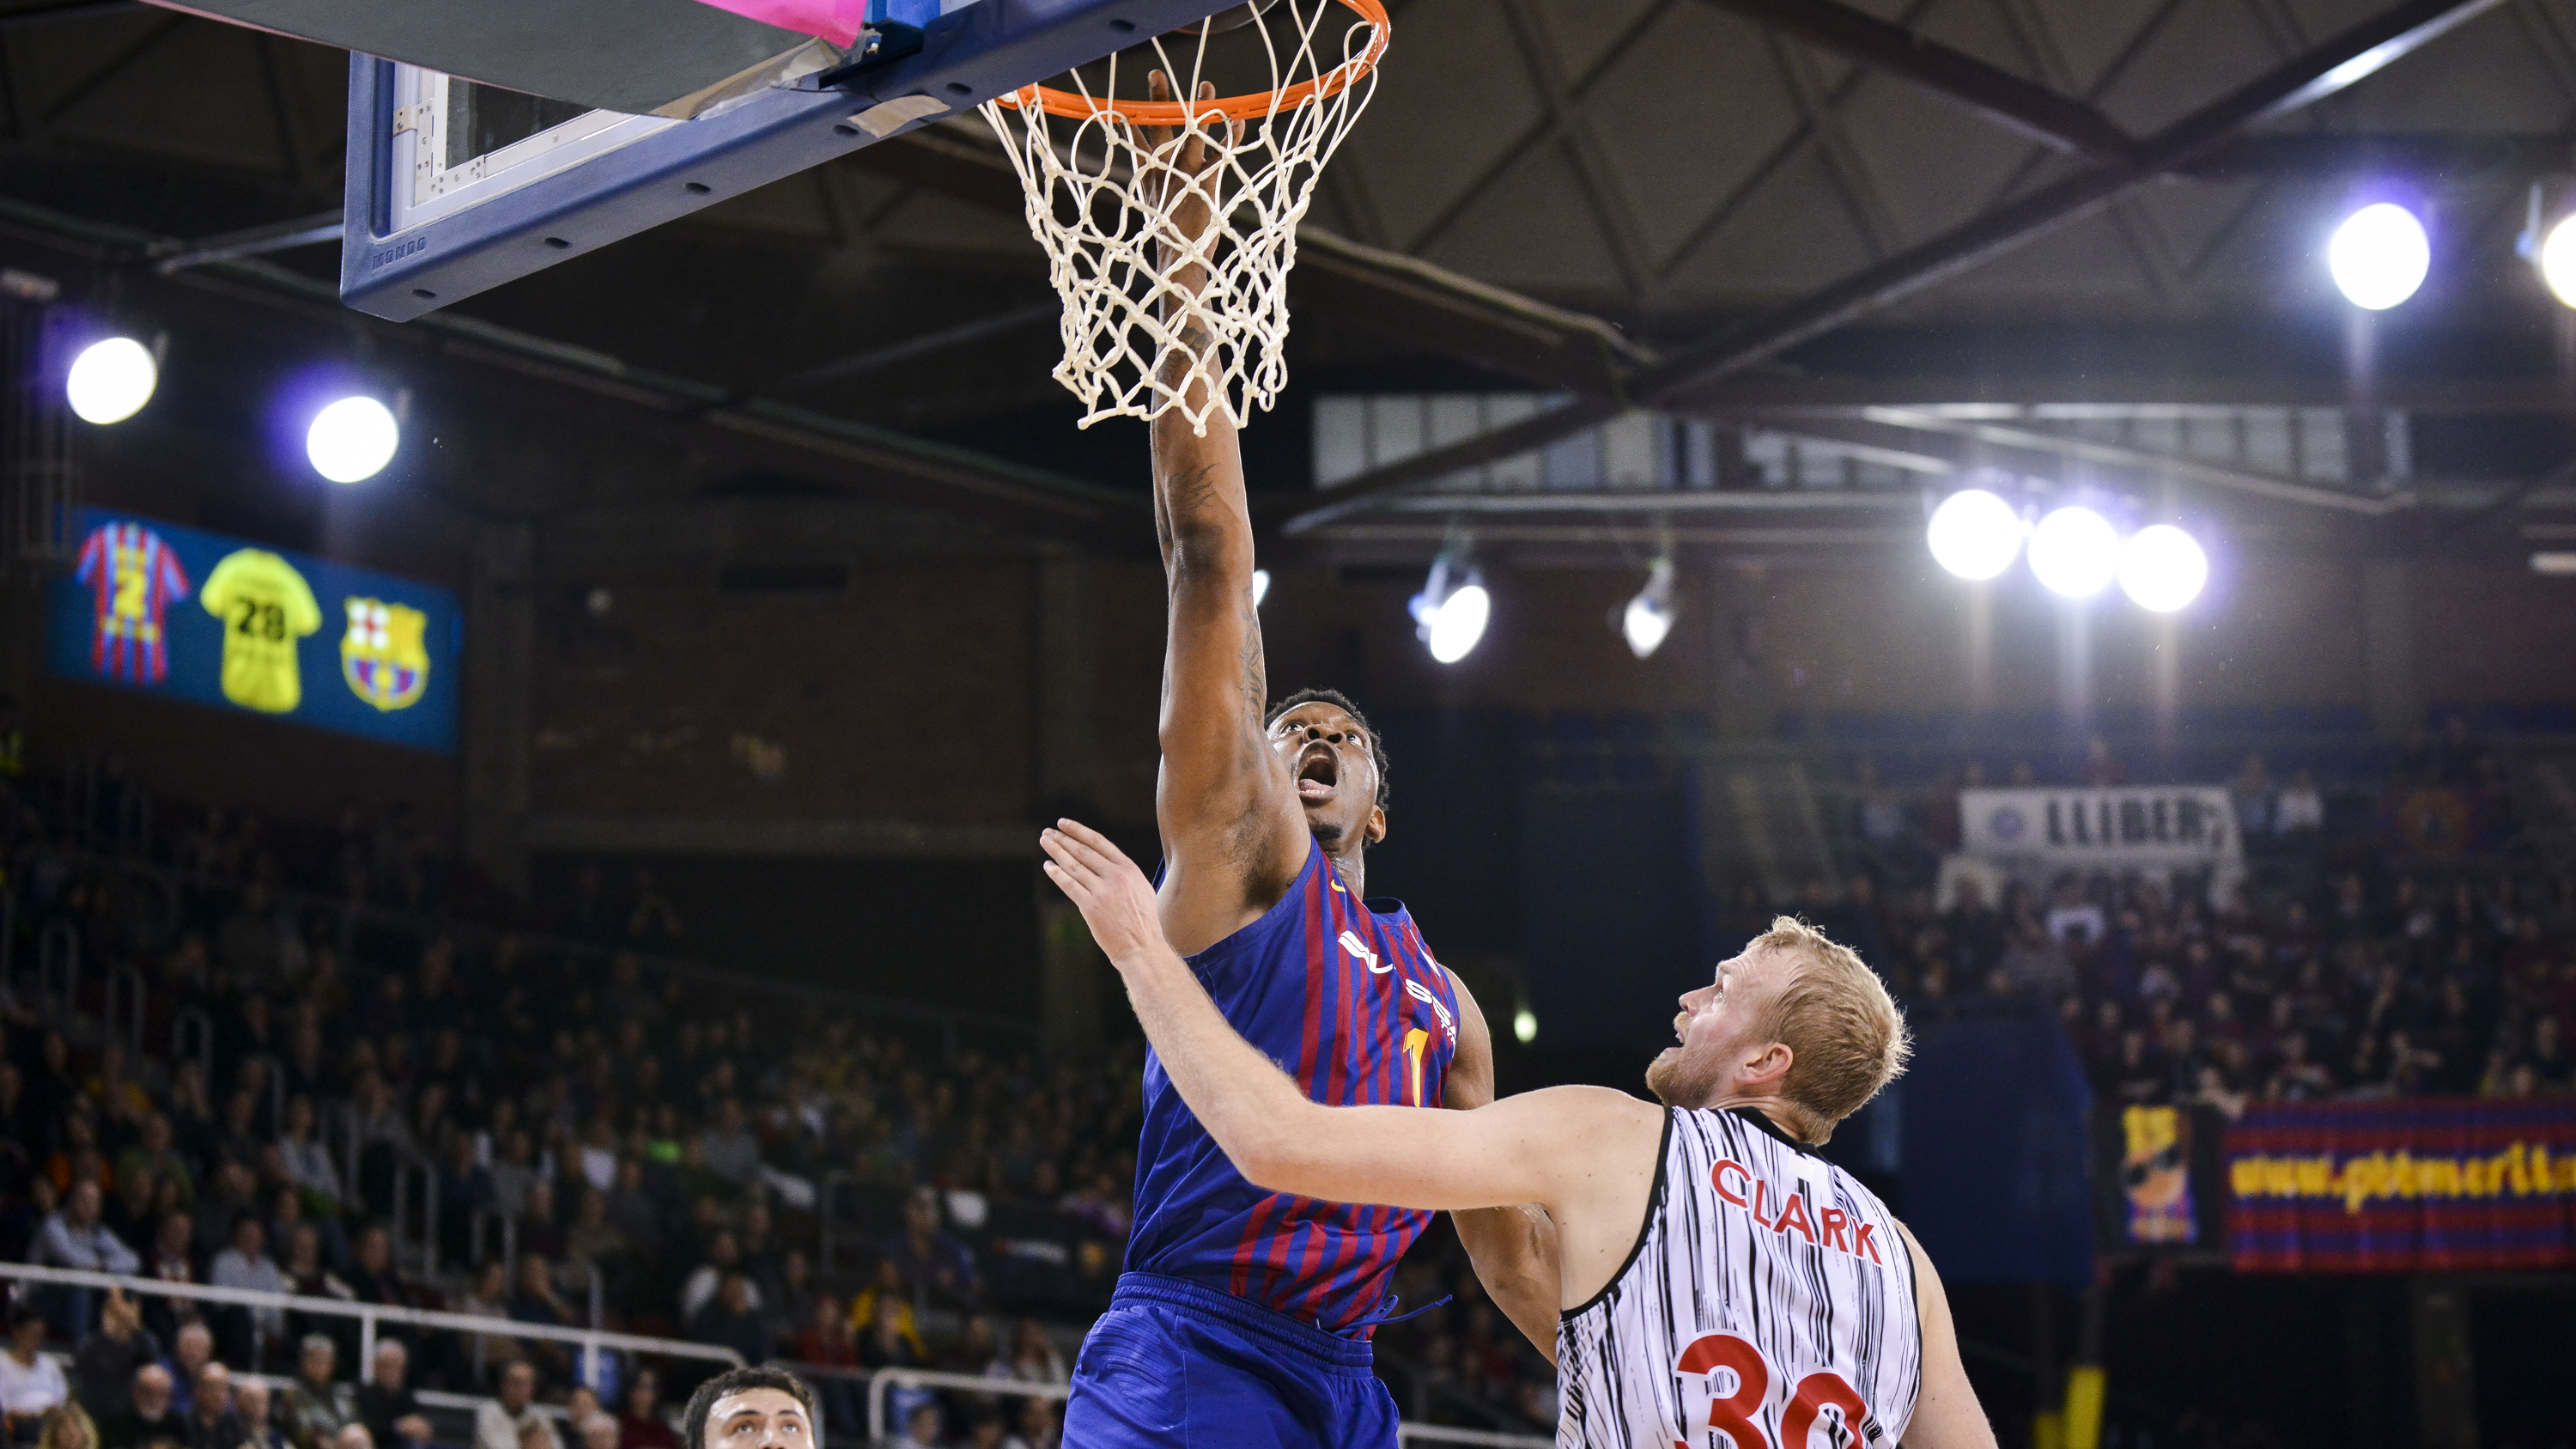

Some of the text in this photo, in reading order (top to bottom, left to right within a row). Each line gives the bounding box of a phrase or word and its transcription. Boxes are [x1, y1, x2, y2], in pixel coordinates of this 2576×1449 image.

[372, 236, 426, 271] MONDO
[237, 595, 286, 642] 28
[1403, 1028, 1429, 1108] 1
[1712, 1160, 1882, 1265] CLARK
